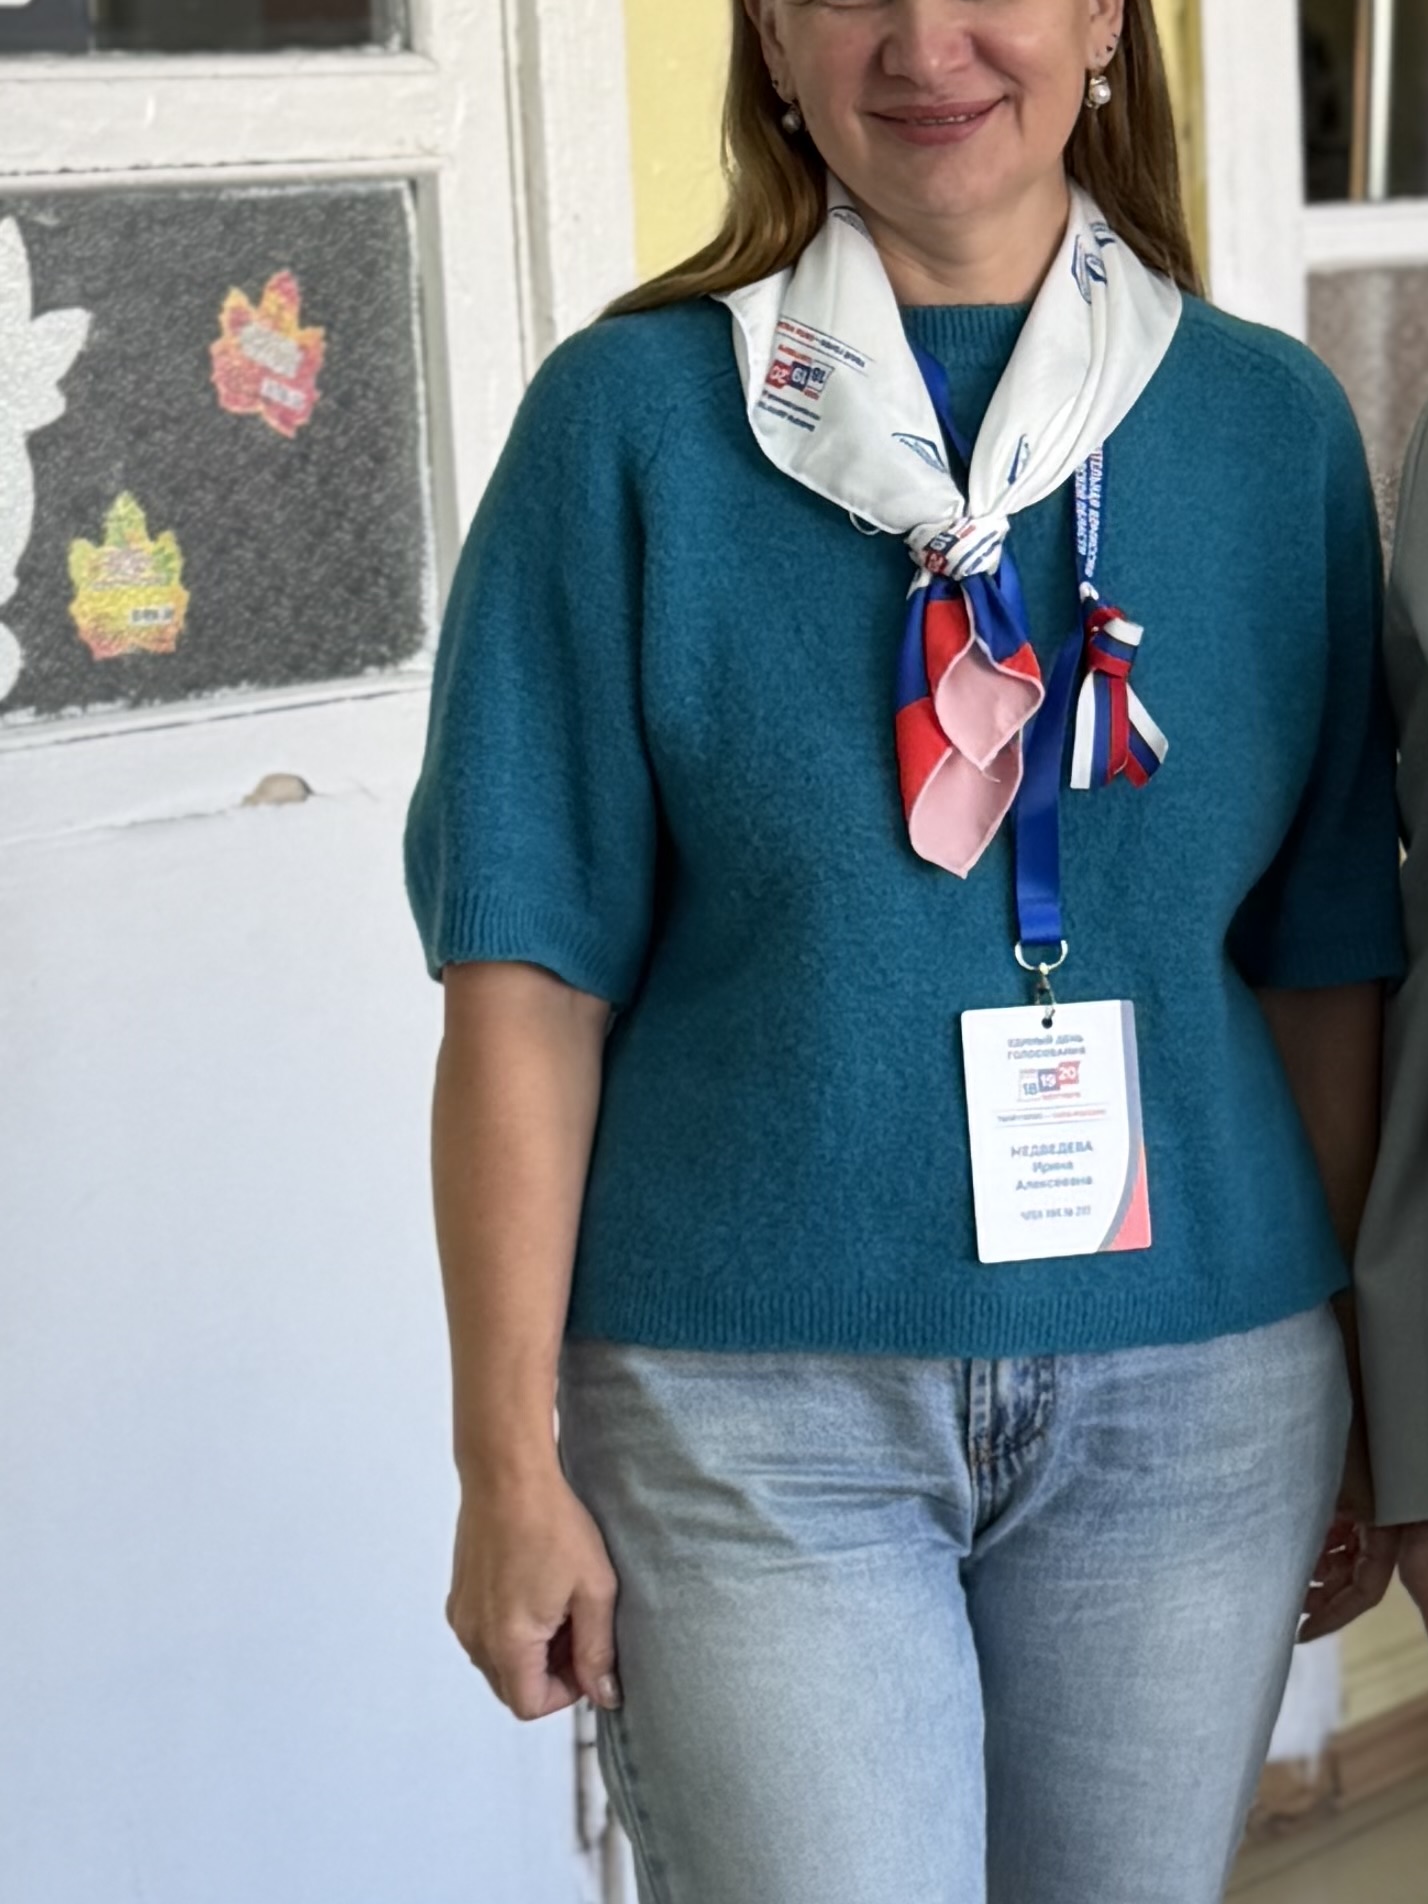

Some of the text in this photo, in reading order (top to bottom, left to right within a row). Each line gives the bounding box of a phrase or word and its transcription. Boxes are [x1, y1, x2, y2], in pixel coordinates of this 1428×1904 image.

[792, 367, 808, 385] 19
[1040, 1072, 1057, 1088] 19
[1058, 1066, 1078, 1081] 20
[1011, 1141, 1094, 1158] МЕДВЕДЕВА
